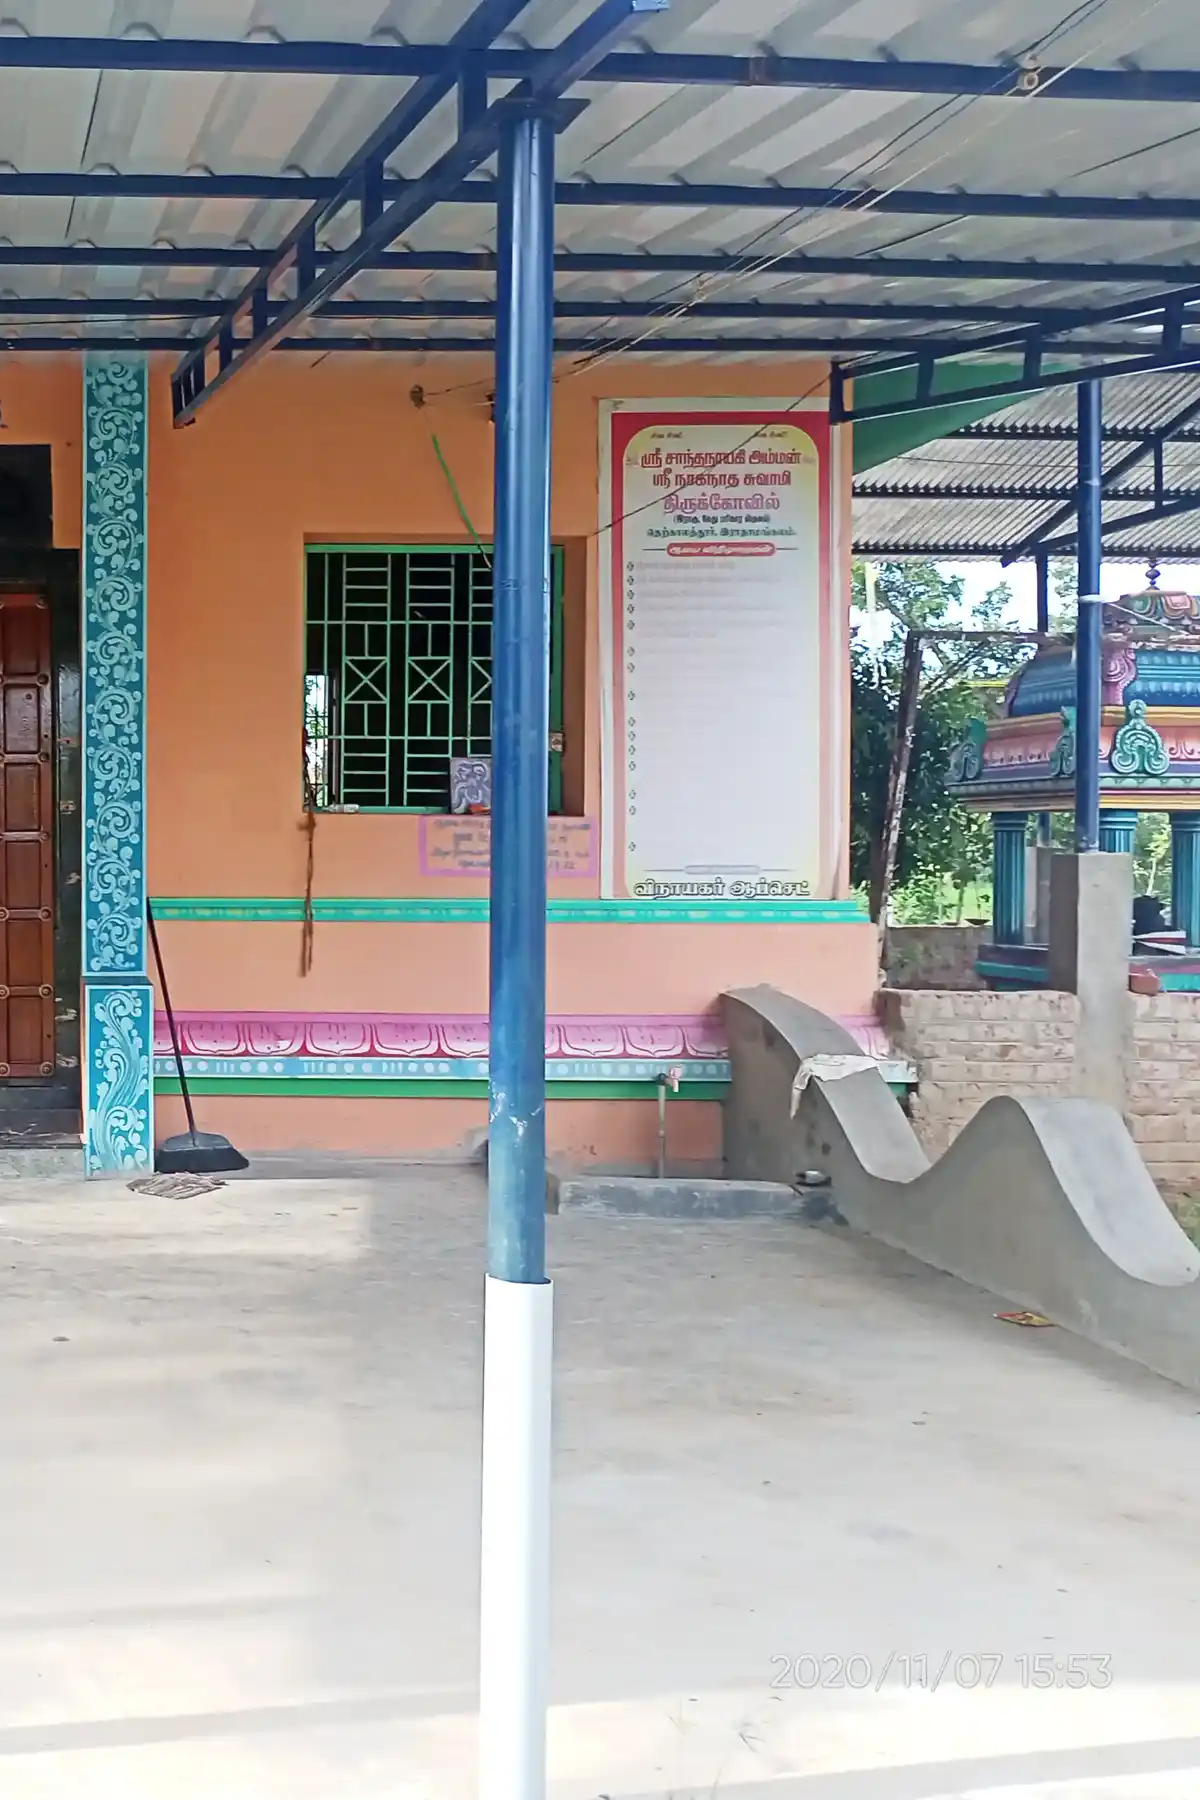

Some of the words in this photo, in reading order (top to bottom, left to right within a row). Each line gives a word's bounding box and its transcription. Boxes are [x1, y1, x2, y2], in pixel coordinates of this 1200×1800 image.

[664, 492, 780, 514] திருக்கோவில்
[634, 877, 726, 899] விநாயகர்
[729, 877, 810, 898] ஆப்செட்
